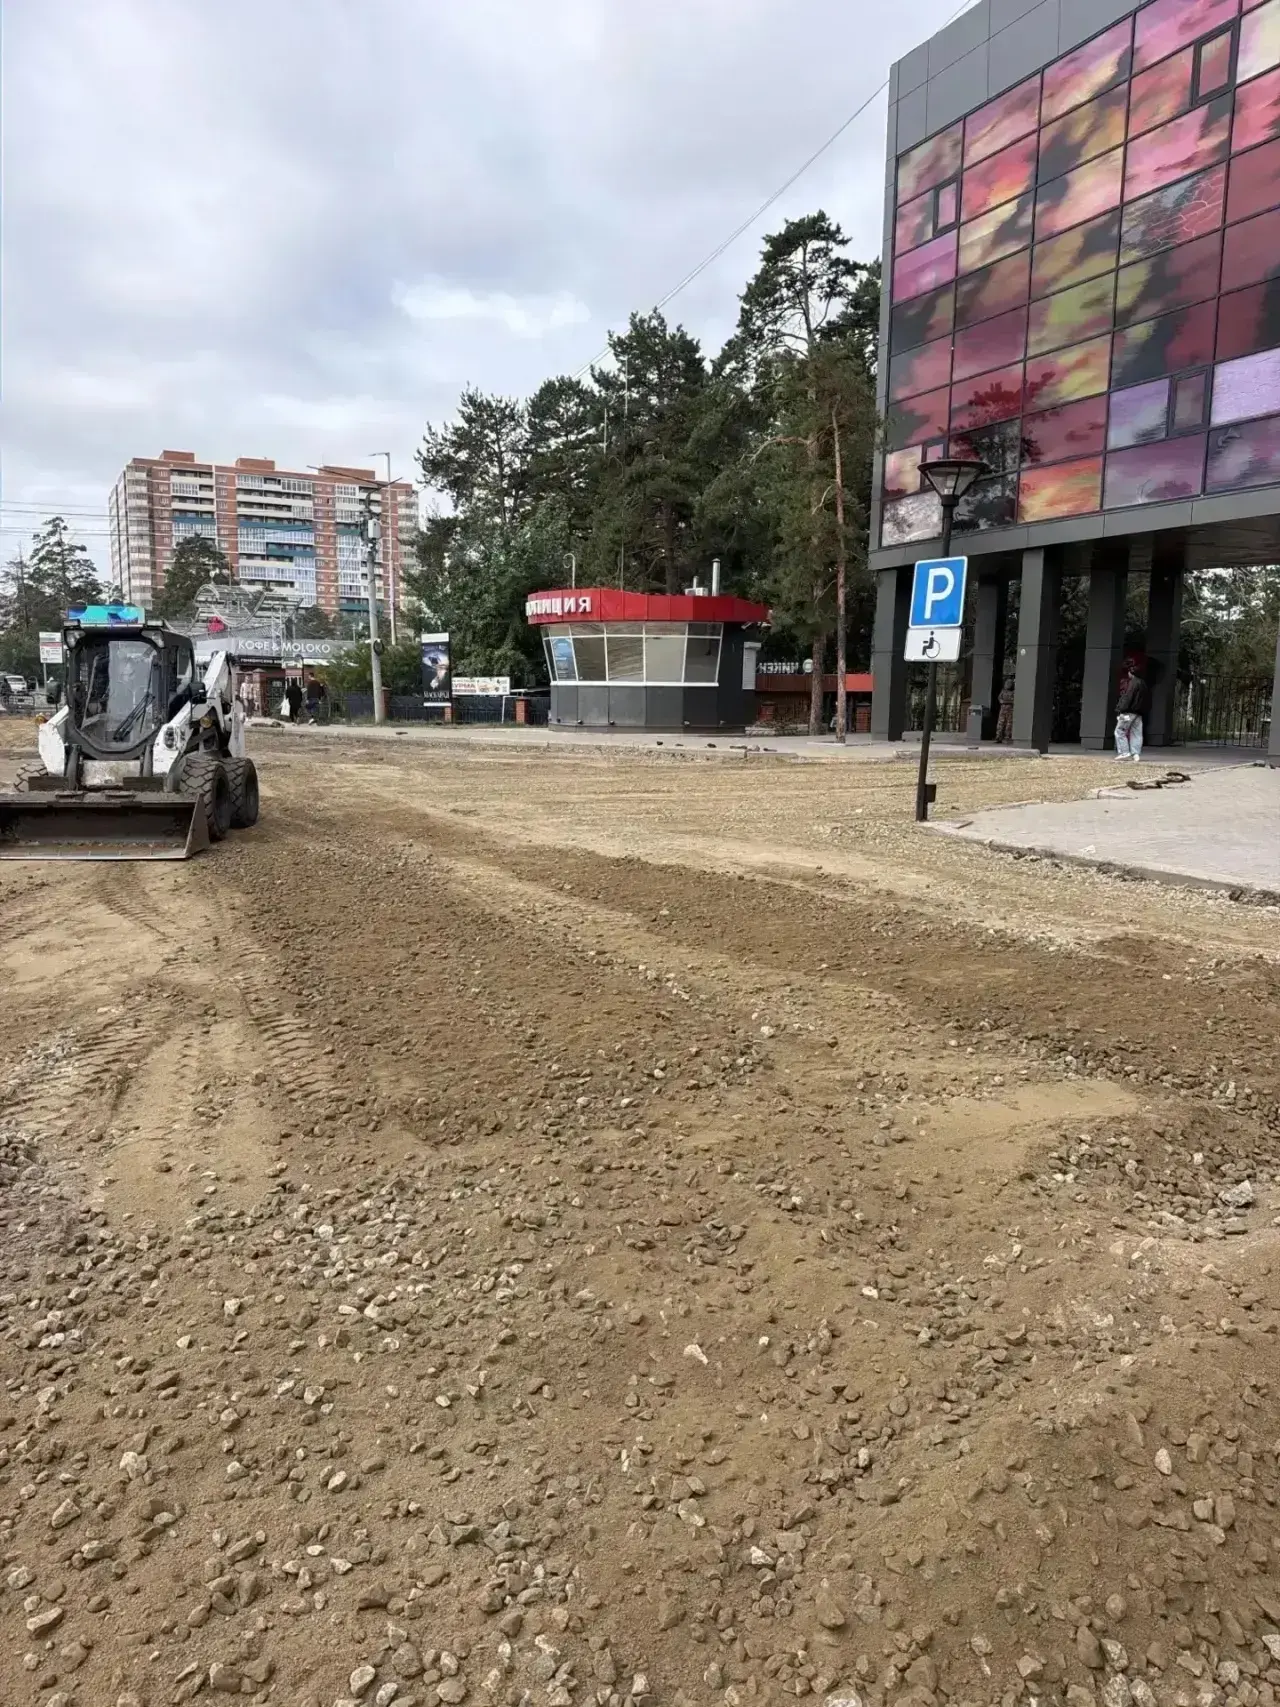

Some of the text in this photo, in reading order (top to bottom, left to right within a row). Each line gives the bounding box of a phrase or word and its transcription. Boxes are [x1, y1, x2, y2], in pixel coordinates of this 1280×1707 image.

[924, 567, 954, 619] P
[525, 596, 592, 616] ЛИЦИЯ
[239, 641, 270, 651] КОФЕ
[282, 643, 331, 653] MOLOKO
